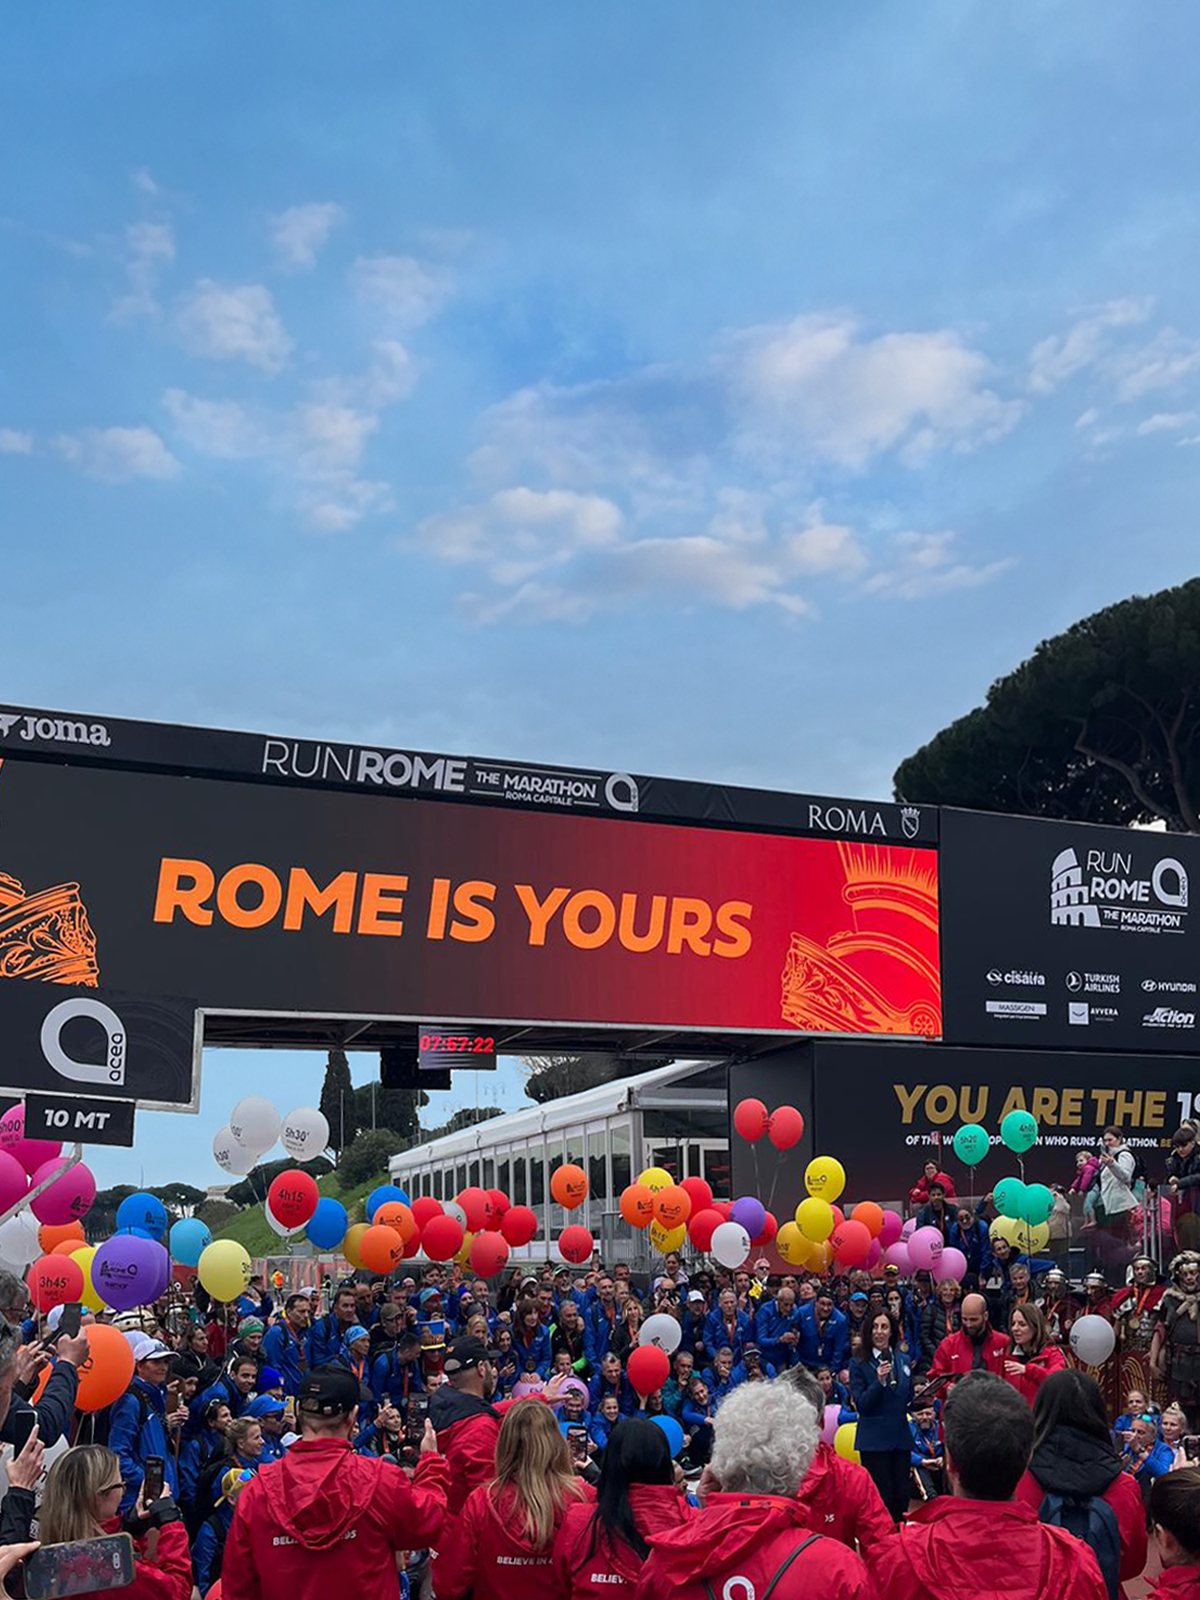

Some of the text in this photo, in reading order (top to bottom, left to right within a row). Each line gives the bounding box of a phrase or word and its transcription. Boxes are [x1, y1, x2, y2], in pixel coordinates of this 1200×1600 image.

[261, 739, 467, 792] RUN ROME
[475, 770, 597, 799] THE MARATHON
[505, 791, 573, 806] ROMA CAPITALE
[808, 804, 888, 836] ROMA
[1086, 850, 1132, 875] RUN
[1090, 876, 1151, 902] ROME
[153, 857, 753, 958] ROME IS YOURS
[1103, 909, 1181, 927] THE MARATHON
[1084, 972, 1120, 983] TURKISH
[1084, 983, 1121, 993] AIRLINES
[1158, 981, 1197, 993] HYUNDAI
[1090, 1007, 1119, 1016] AVVERA
[109, 1032, 124, 1082] acea
[893, 1084, 990, 1125] YOU
[998, 1086, 1084, 1127] ARE
[1090, 1088, 1168, 1128] THE
[44, 1109, 111, 1130] 10 MT
[905, 1135, 920, 1146] OF
[1044, 1135, 1068, 1147] WHO
[1070, 1135, 1096, 1147] RUNS
[590, 1573, 628, 1585] BELIEV
